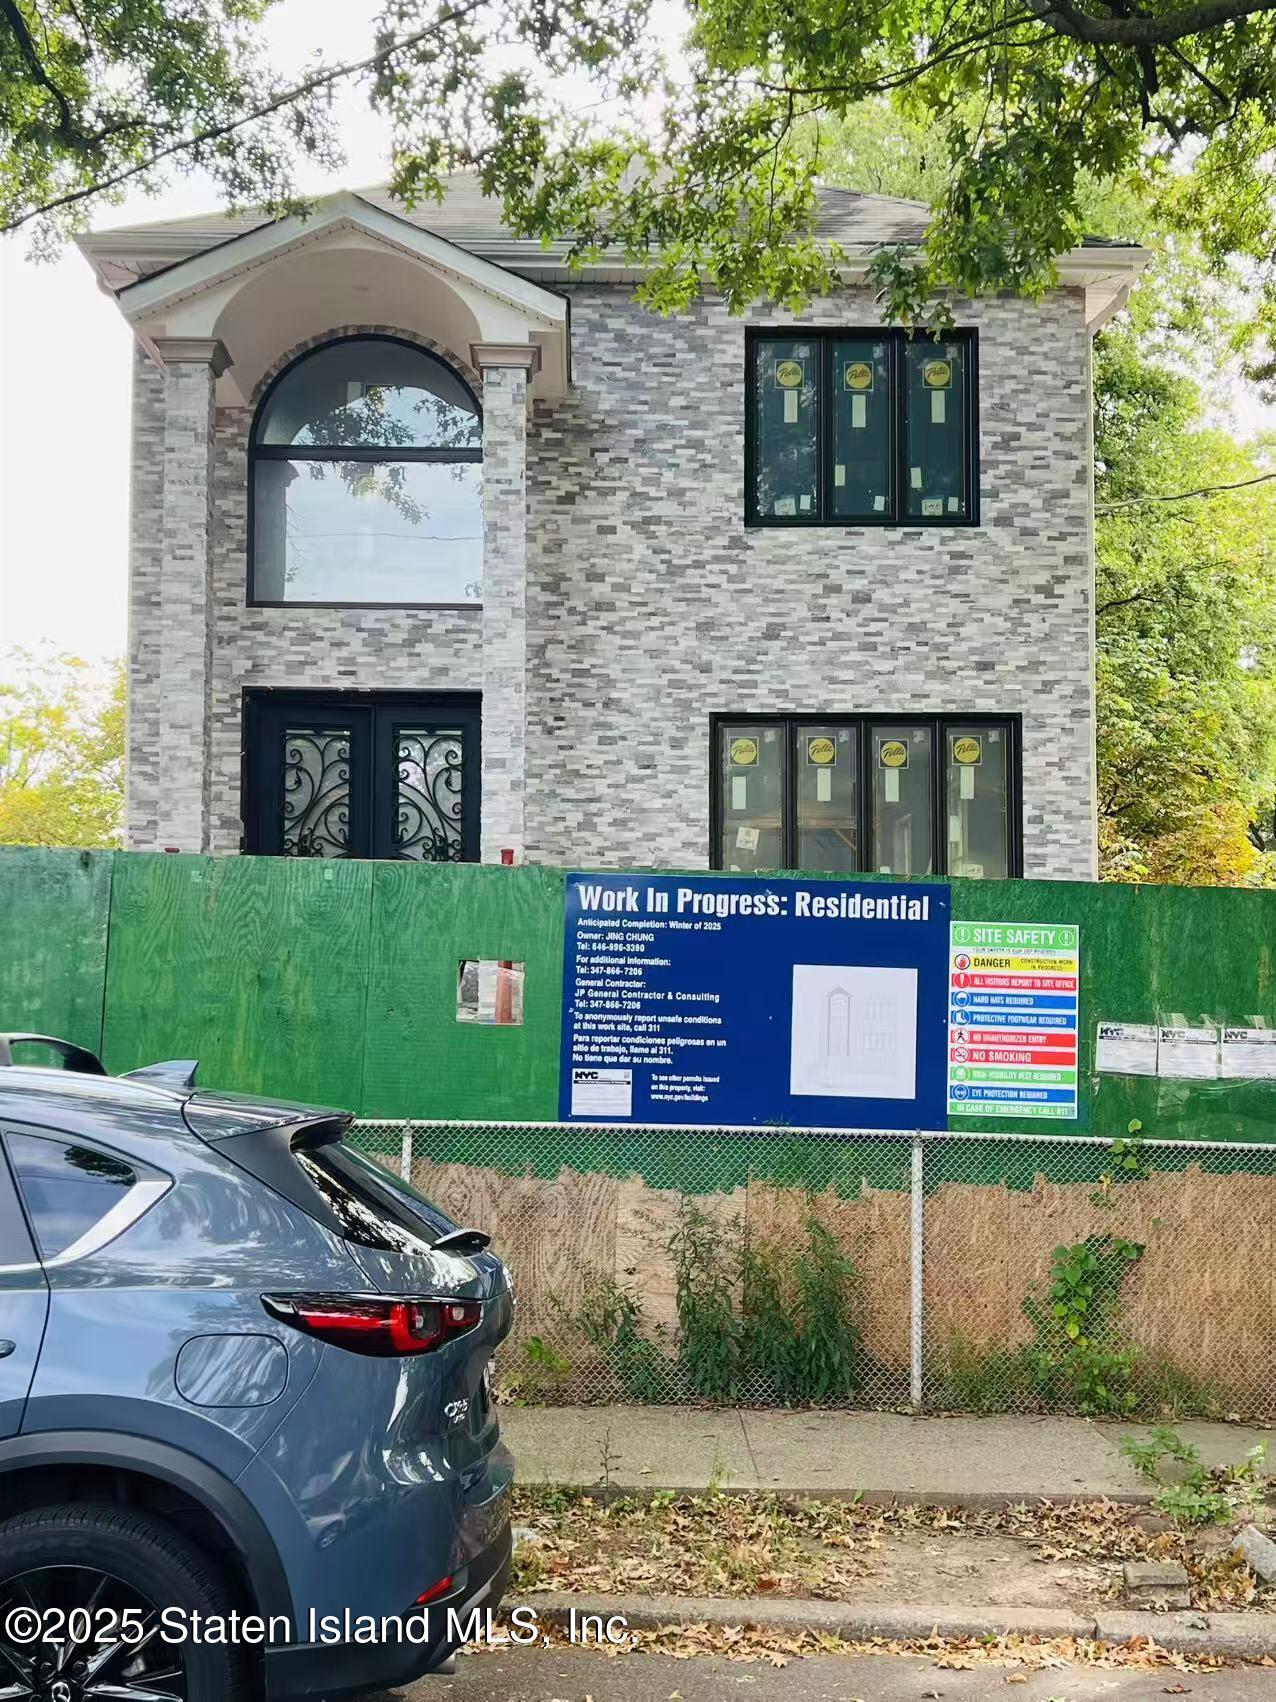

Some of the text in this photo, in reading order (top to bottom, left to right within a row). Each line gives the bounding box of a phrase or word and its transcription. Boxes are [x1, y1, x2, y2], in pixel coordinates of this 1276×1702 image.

[731, 744, 755, 755] Pella
[811, 743, 834, 755] Pella
[882, 746, 905, 757] Pella
[956, 743, 979, 754] Pella
[579, 885, 929, 920] Work In Progress: Residential
[578, 918, 619, 928] Anticipated
[622, 920, 667, 929] Completion:
[669, 921, 691, 929] Winter
[577, 931, 604, 940] Owner:
[626, 933, 654, 941] CHUNG
[974, 928, 1056, 945] SITE SAFETY
[577, 942, 590, 950] Tel:
[576, 955, 671, 966] For additional information:
[974, 958, 1010, 967] DANGER
[575, 978, 646, 988] General Contractor:
[575, 989, 585, 997] JP
[588, 989, 619, 998] General
[622, 990, 664, 999] Contractor
[676, 992, 719, 1003] Consulting
[973, 996, 989, 1004] HARD
[1006, 997, 1033, 1005] REQUIRED
[575, 999, 588, 1008] Tel:
[574, 1012, 721, 1024] To anonymously report unsafe conditions
[973, 1015, 1006, 1023] PROTECTIVE
[1039, 1016, 1066, 1025] REQUIRED
[617, 1024, 632, 1032] site,
[573, 1034, 590, 1042] Para
[591, 1035, 620, 1044] reportar
[622, 1036, 665, 1044] condiciones
[667, 1037, 704, 1047] peligrosas
[1224, 1031, 1248, 1039] NYC
[601, 1045, 628, 1054] trabajo,
[630, 1045, 649, 1053] llame
[651, 1046, 657, 1054] al
[573, 1053, 583, 1061] No
[585, 1053, 602, 1062] tiene
[604, 1055, 617, 1063] que
[619, 1054, 631, 1062] dar
[644, 1055, 672, 1064] nombre.
[973, 1051, 1031, 1062] NO SMOKING
[575, 1071, 598, 1079] NYC
[972, 1088, 1047, 1099] EYE PROTECTION REQUIRED
[966, 1103, 984, 1112] CASE
[985, 1104, 993, 1112] OF
[996, 1104, 1036, 1114] EMERGENCY
[1039, 1106, 1055, 1114] CALL
